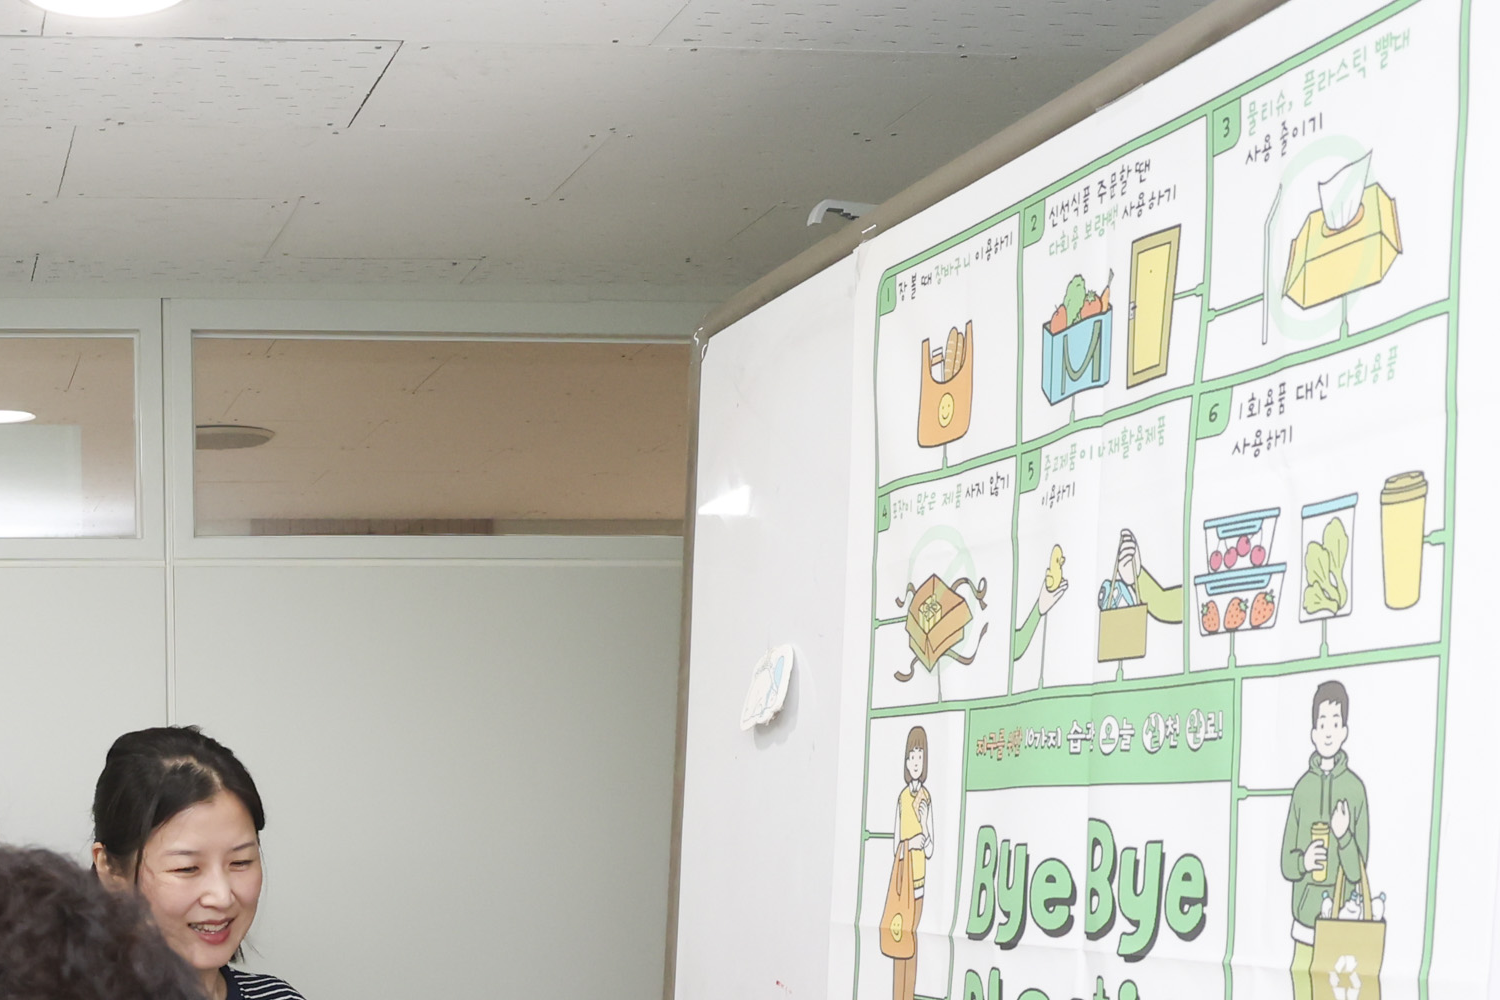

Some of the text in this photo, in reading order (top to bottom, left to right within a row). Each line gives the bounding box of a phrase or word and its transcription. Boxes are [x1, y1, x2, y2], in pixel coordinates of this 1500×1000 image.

[1247, 27, 1411, 137] 물티슈, 플라스틱 빨대
[1222, 117, 1230, 138] 3
[1244, 112, 1323, 165] 사용 줄이기
[1049, 159, 1151, 228] 신선식품 주문할 땐
[1030, 214, 1038, 232] 2
[1049, 225, 1080, 256] 다회용
[1121, 184, 1177, 219] 사용하기
[898, 231, 1013, 301] 장 볼 때 장바구니 이용하기
[1238, 345, 1399, 420] 1회용품 대신 다회용품
[1208, 402, 1220, 423] 6
[1231, 425, 1293, 458] 사용하기
[916, 492, 937, 516] 많은
[942, 483, 962, 509] 제품
[965, 481, 985, 499] 사지
[989, 471, 1010, 496] 않기
[1028, 461, 1035, 481] 5
[1041, 481, 1076, 510] 이용하기
[1100, 715, 1135, 755] 오늘
[1142, 711, 1180, 754] 실천
[965, 817, 1209, 963] Bye Bye
